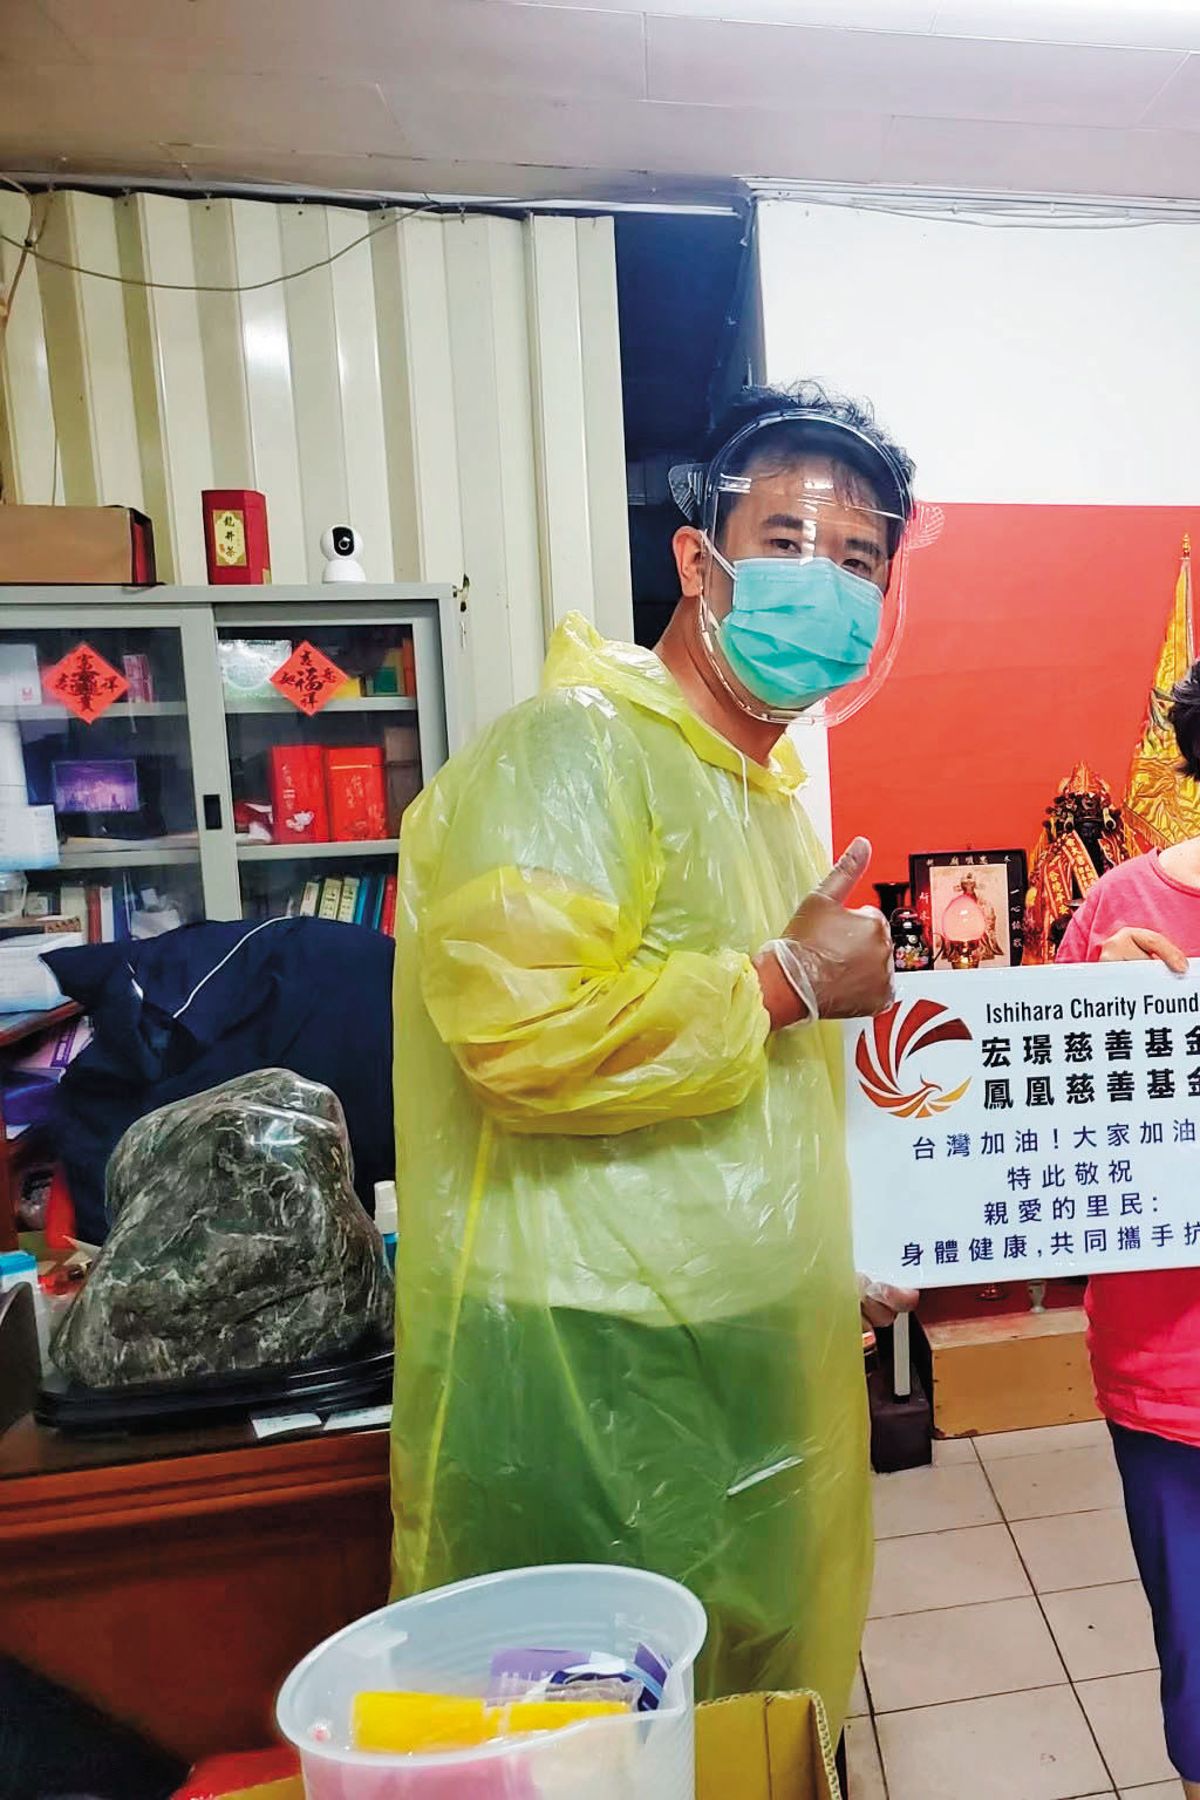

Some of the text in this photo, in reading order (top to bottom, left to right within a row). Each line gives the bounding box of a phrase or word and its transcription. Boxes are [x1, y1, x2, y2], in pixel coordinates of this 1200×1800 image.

[986, 1001, 1065, 1024] Ishihara
[1070, 996, 1137, 1020] Charity
[1006, 1159, 1133, 1191] 特此敬祝
